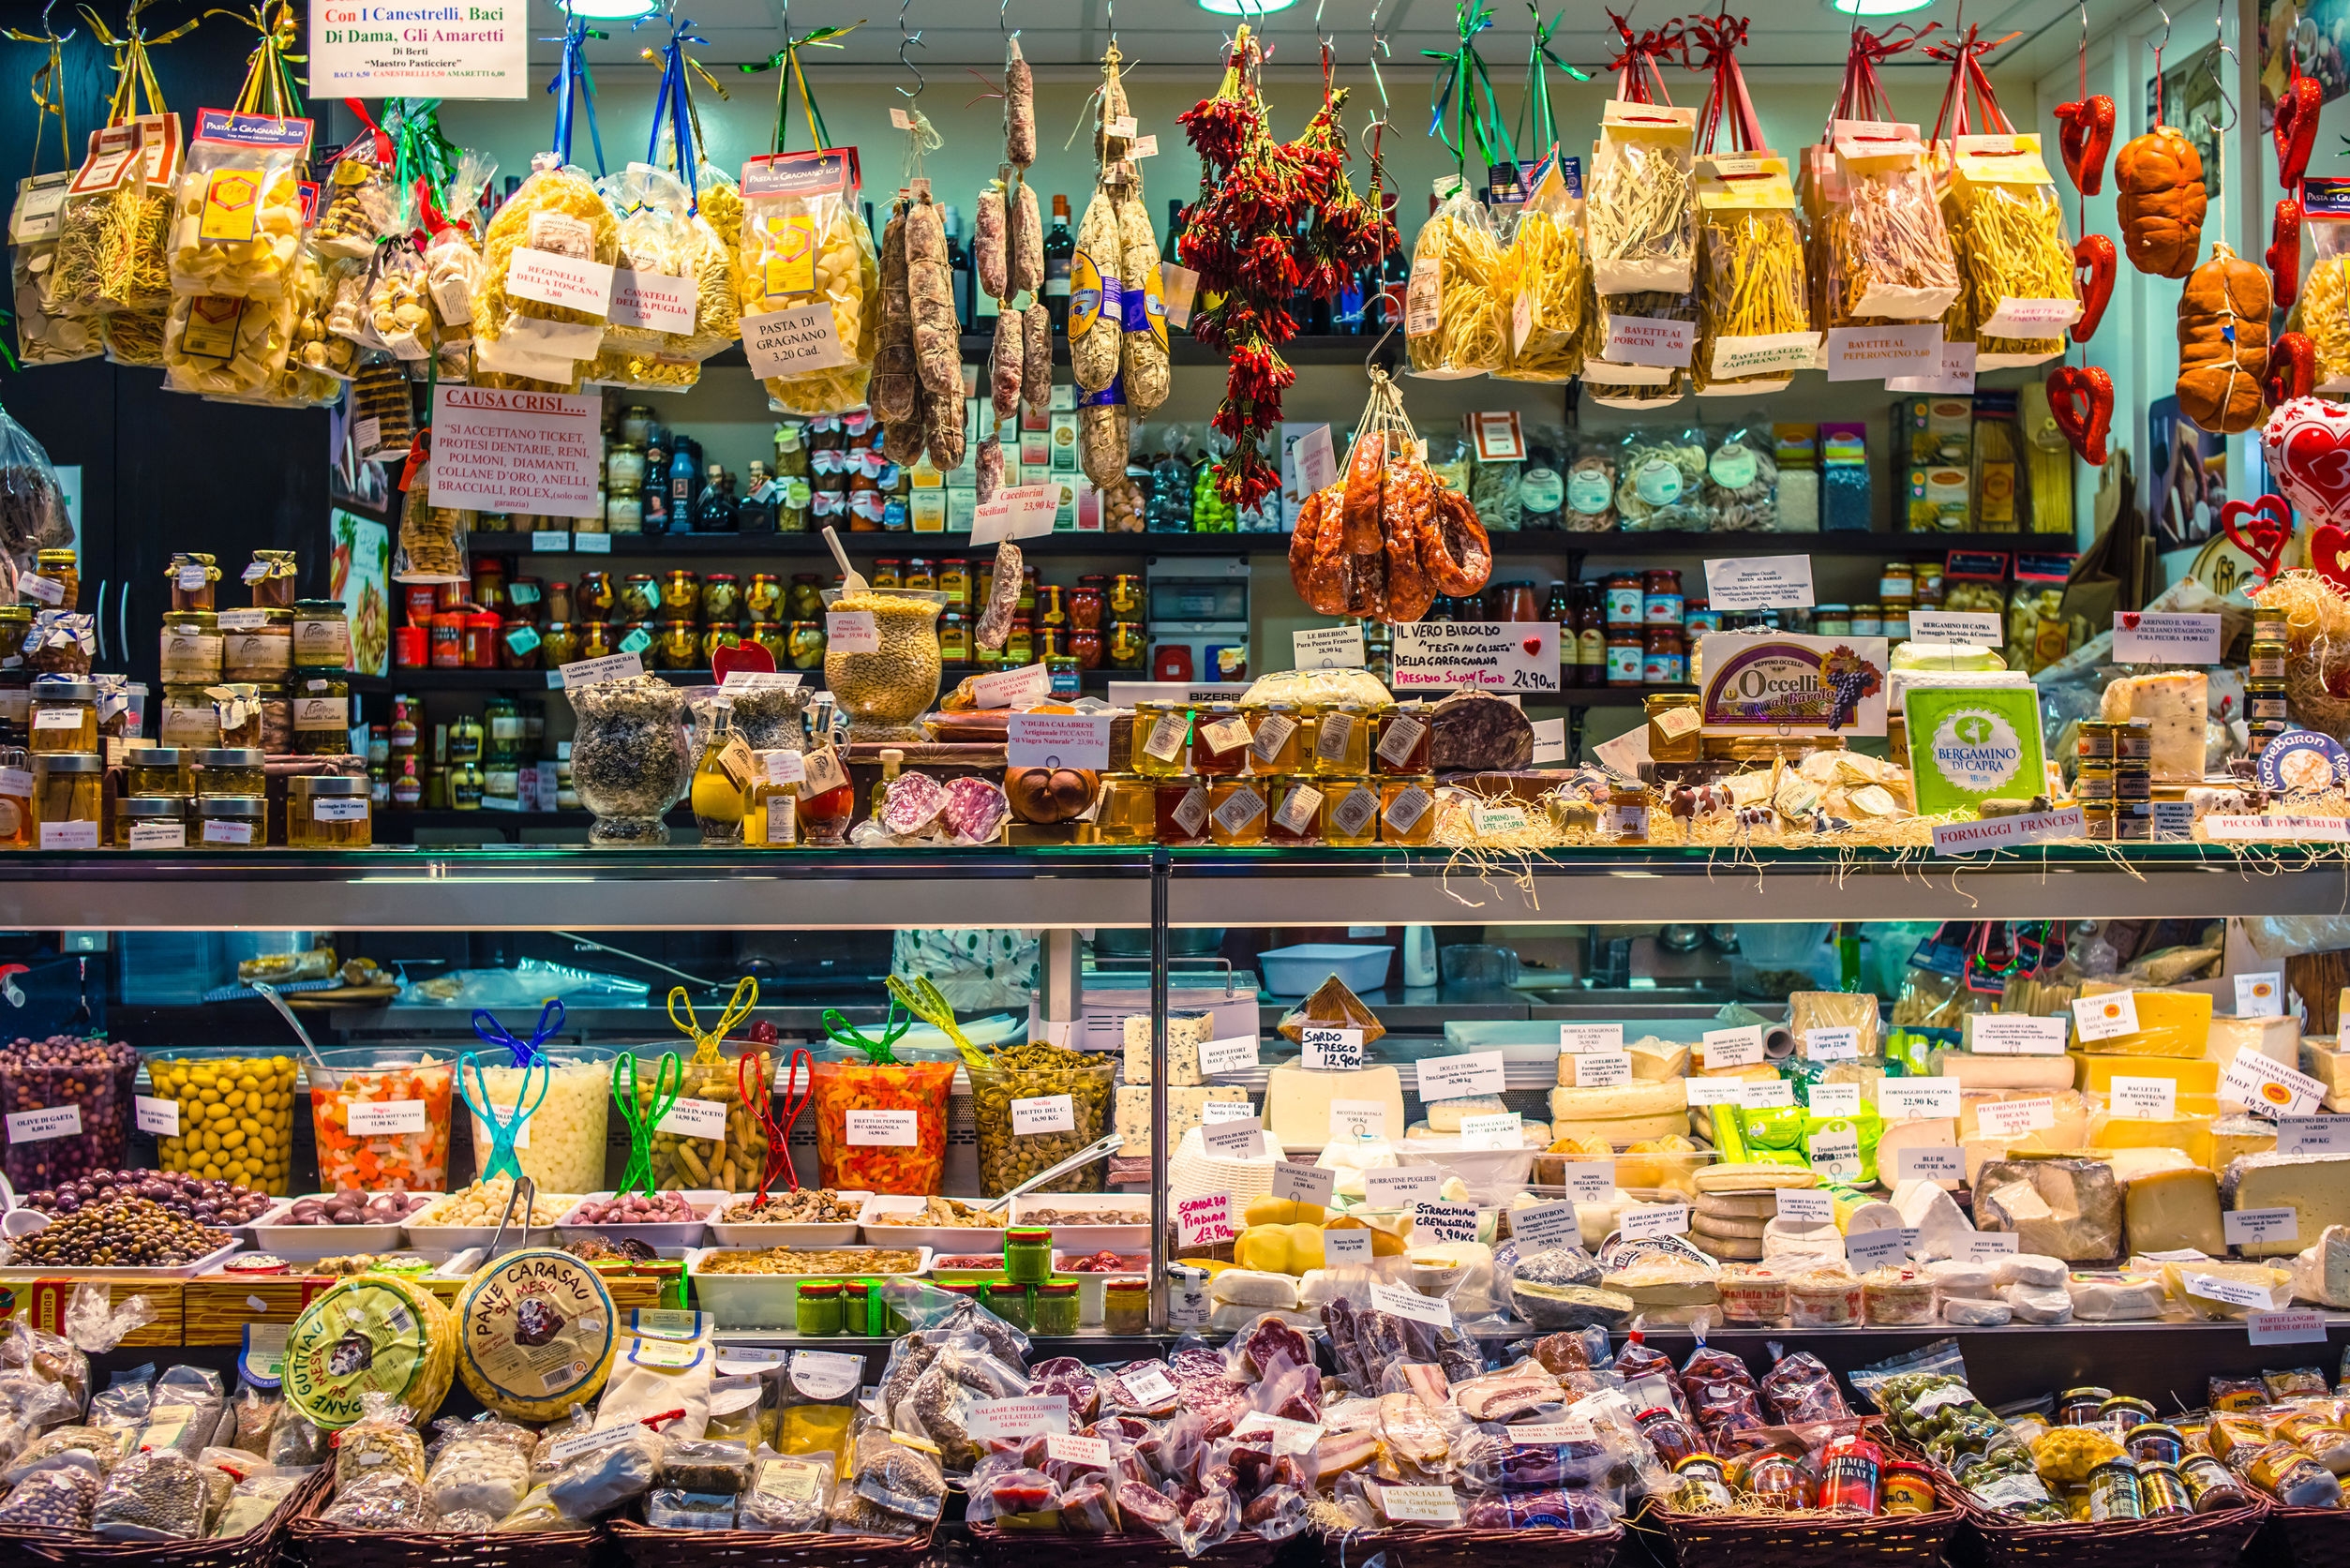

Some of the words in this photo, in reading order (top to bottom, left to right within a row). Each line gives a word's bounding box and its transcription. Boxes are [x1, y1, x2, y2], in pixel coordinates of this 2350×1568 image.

[325, 8, 356, 22] Con
[362, 8, 368, 22] I
[373, 7, 464, 23] Canestrelli,
[469, 7, 503, 22] Baci
[325, 30, 343, 44] Di
[349, 29, 398, 45] Dama,
[404, 28, 427, 43] Gli
[432, 28, 504, 43] Amaretti
[406, 47, 428, 55] Berti
[749, 172, 772, 183] PASTA
[528, 266, 586, 284] REGINELLE
[516, 273, 551, 287] DELLA
[553, 280, 599, 297] TOSCANA
[545, 289, 562, 299] 3,80
[624, 288, 678, 303] CAVATELLI
[616, 297, 648, 309] DELLA
[651, 303, 688, 315] PUGLIA
[759, 321, 797, 336] PASTA
[801, 317, 815, 327] DI
[756, 329, 827, 351] GRAGNANO
[1614, 336, 1654, 347] PORCINI
[1666, 340, 1683, 350] 4,90
[772, 351, 795, 363] 3,20
[797, 346, 821, 357] Cad.
[1731, 351, 1774, 360] BAVETTE
[1843, 351, 1911, 360] PEPERONCINO
[446, 389, 509, 409] CAUSA
[466, 425, 536, 441] ACCETTANO
[539, 431, 586, 444] TICKET,
[440, 438, 488, 450] PROTESI
[491, 441, 555, 456] DENTARIE,
[558, 447, 590, 459] RENI,
[449, 454, 507, 468] POLMONI,
[513, 457, 579, 472] DIAMANTI,
[438, 467, 494, 480] COLLANE
[542, 475, 590, 487] ANELLI,
[438, 481, 506, 497] BRACCIALI,
[574, 493, 589, 501] con
[494, 499, 529, 509] garanzia)
[977, 505, 1008, 517] Siciliani
[1024, 500, 1044, 512] 23,90
[1046, 500, 1055, 511] kg
[1318, 630, 1348, 639] BREBION
[1397, 625, 1408, 638] IL
[1412, 624, 1443, 637] VERO
[1446, 625, 1500, 637] BIROLDO
[566, 665, 591, 674] CAPPERI
[591, 661, 613, 669] GRANDI
[614, 656, 635, 665] SICILIA
[1754, 659, 1779, 668] BEPPINO
[1779, 659, 1804, 668] OCCELLI
[1396, 671, 1441, 685] PRESIDIO
[1444, 670, 1477, 683] SLOW
[1478, 669, 1505, 683] FOOD
[1739, 669, 1819, 699] Occelli
[999, 680, 1030, 692] PICCANTE
[1190, 693, 1244, 701] BIZERB
[1771, 695, 1785, 708] al
[1788, 688, 1835, 705] Barolo
[1024, 729, 1058, 738] Artigianale
[1022, 738, 1043, 746] Viagra
[1938, 748, 2015, 761] BERGAMINO
[1953, 760, 1964, 770] DI
[1966, 760, 2004, 772] CAPRA
[1940, 823, 2012, 843] FORMAGGI
[2021, 814, 2079, 831] FRANCESI
[2223, 819, 2273, 828] PICCOLI
[2277, 818, 2326, 829] PIACERI
[1302, 1031, 1342, 1043] SARDO
[1208, 1047, 1247, 1057] ROQUEFORT
[1313, 1043, 1357, 1053] FRESCO
[2236, 1057, 2280, 1083] VALDOSTANA
[2254, 1057, 2264, 1066] LA
[2266, 1062, 2283, 1074] VERA
[2285, 1071, 2314, 1089] FONTINA
[1903, 1098, 1924, 1106] 22,90
[1926, 1098, 1939, 1108] Kg
[1995, 1111, 2029, 1120] TOSCANA
[1217, 1137, 1250, 1146] PIEMONTESE
[1816, 1144, 1849, 1153] Tronchetto
[1278, 1167, 1308, 1177] SCAMORZE
[1309, 1172, 1327, 1181] DELLA
[1178, 1196, 1226, 1214] SCAMORZA
[1522, 1208, 1565, 1222] ROCHEBON
[476, 1283, 505, 1337] PANE
[506, 1262, 590, 1301] CARASAU
[496, 1299, 512, 1317] SU
[2302, 1322, 2324, 1330] ITALY
[975, 1406, 1009, 1414] SALAME
[1010, 1404, 1063, 1412] STROLGHINO
[1050, 1436, 1086, 1447] SALAME
[1059, 1443, 1095, 1454] NAPOLI
[1388, 1489, 1445, 1499] GUANCIALE
